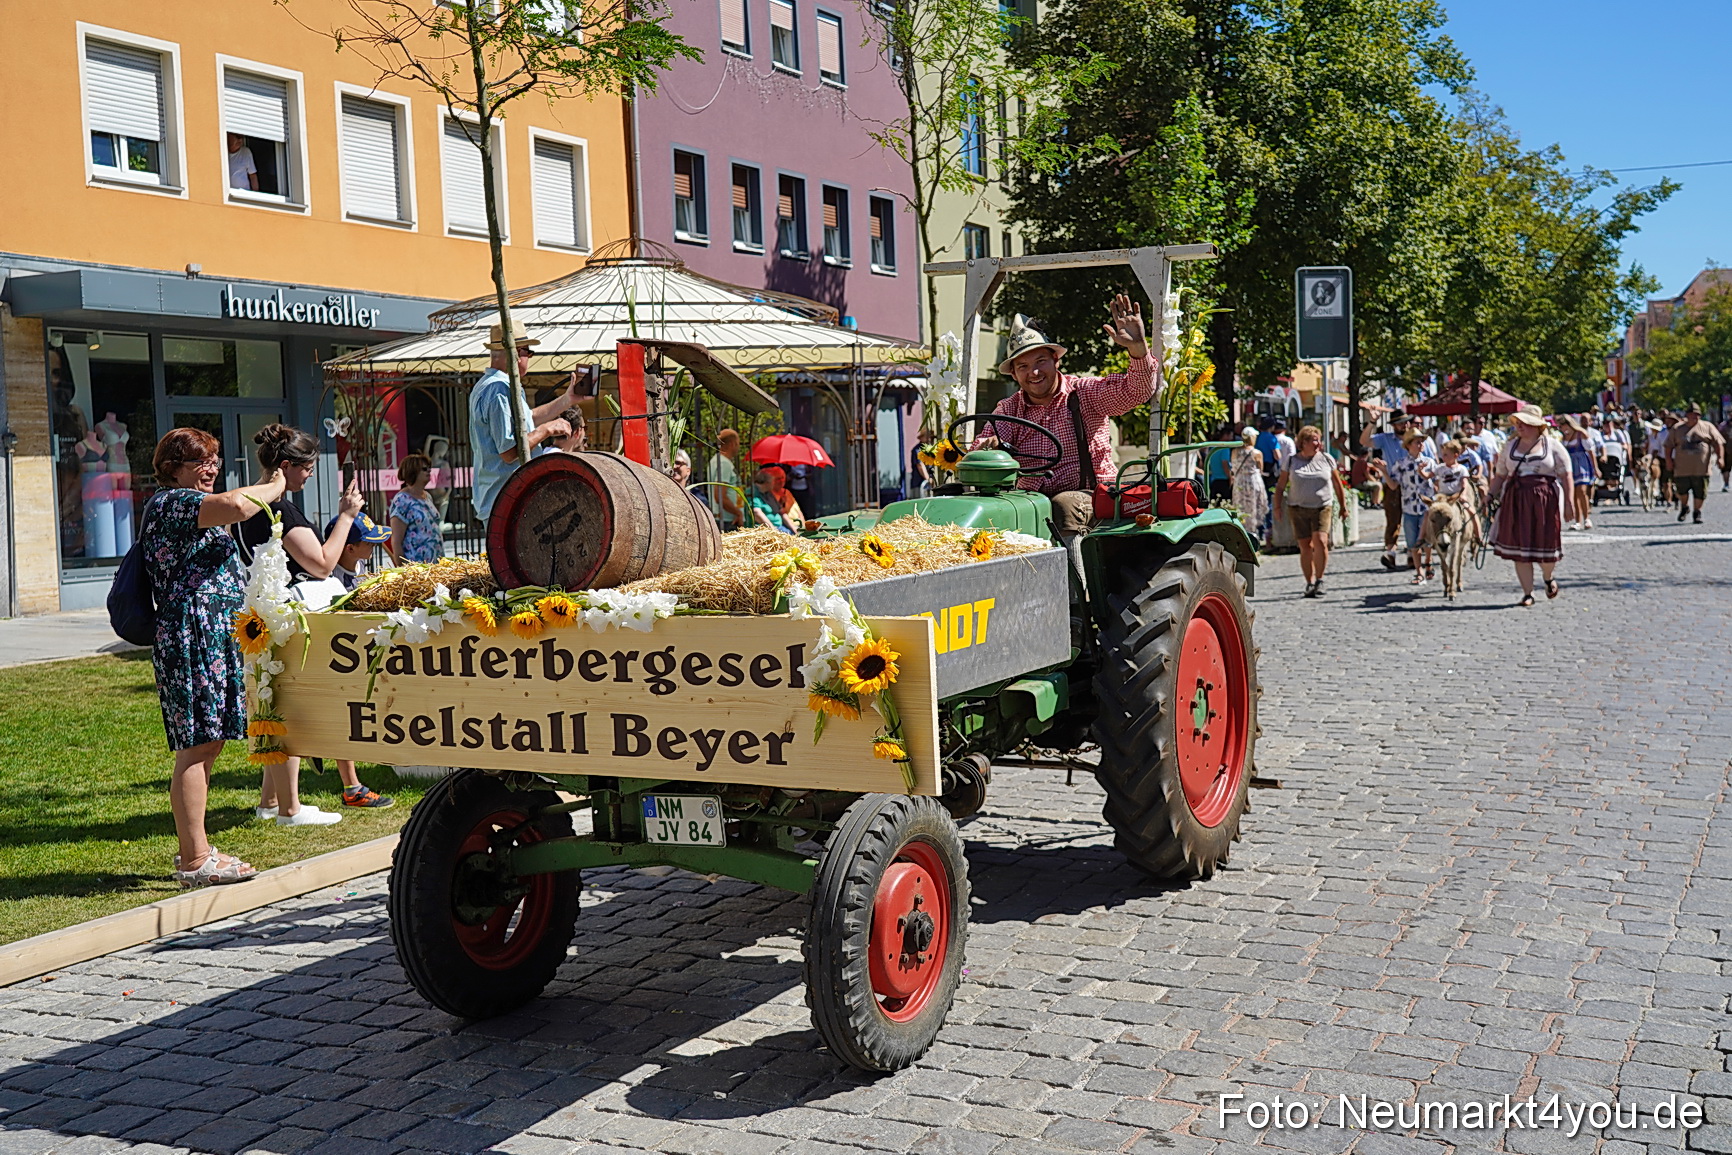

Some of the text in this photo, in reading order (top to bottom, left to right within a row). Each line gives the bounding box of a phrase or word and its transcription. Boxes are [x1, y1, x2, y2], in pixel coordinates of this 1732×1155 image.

[1314, 307, 1334, 315] ZONE
[328, 632, 807, 696] Stauferbergesel
[347, 701, 796, 772] Eselstall Beyer
[657, 798, 684, 819] NM
[657, 821, 713, 842] JY 84
